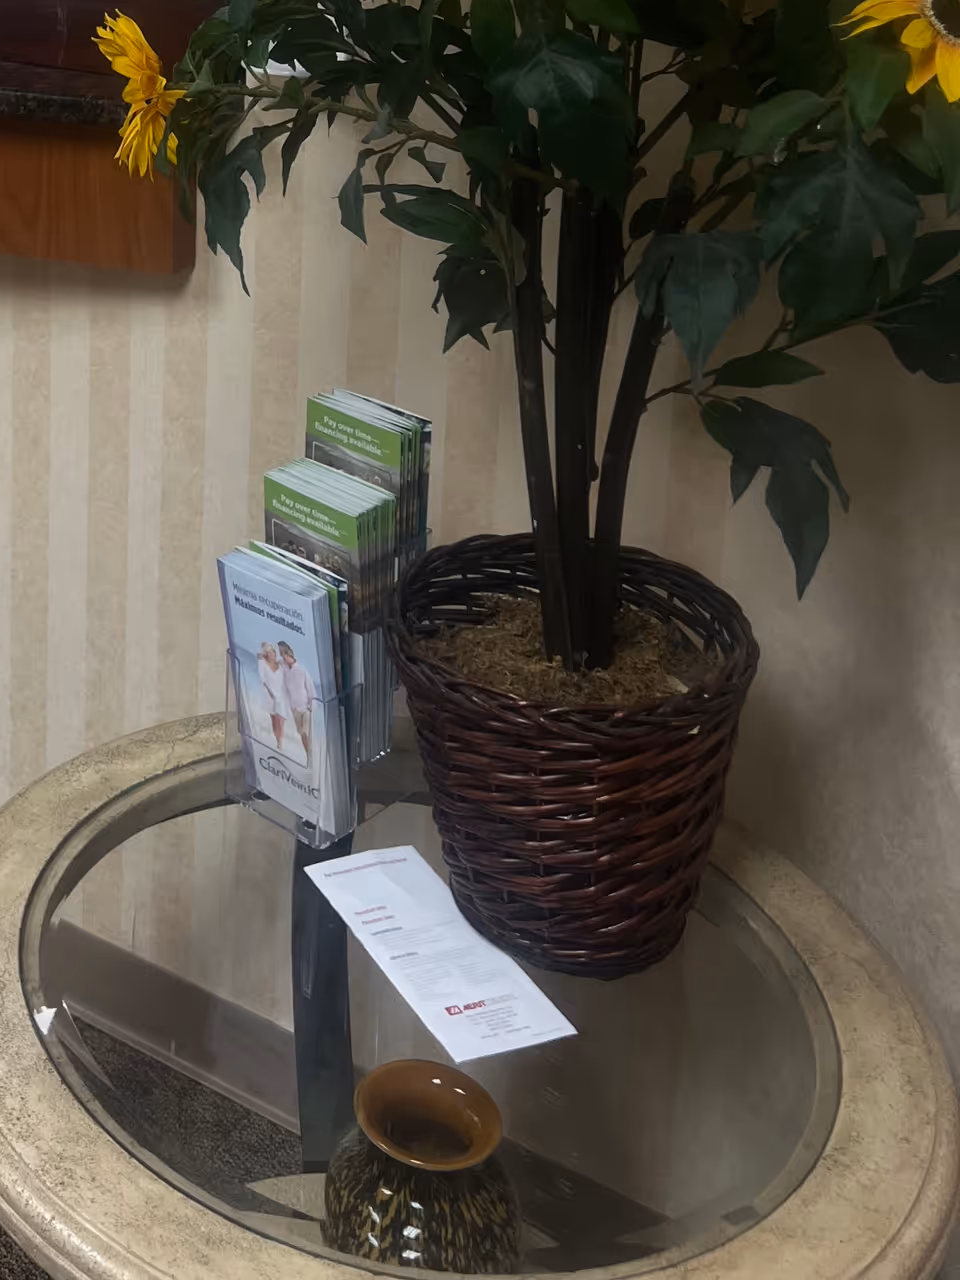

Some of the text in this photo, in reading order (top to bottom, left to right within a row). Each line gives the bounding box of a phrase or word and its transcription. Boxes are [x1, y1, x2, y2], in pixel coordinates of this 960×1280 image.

[314, 421, 348, 443] financing
[323, 415, 337, 428] Pay
[337, 423, 354, 434] over
[272, 498, 305, 523] financing
[280, 493, 294, 507] Pay
[294, 502, 311, 514] over
